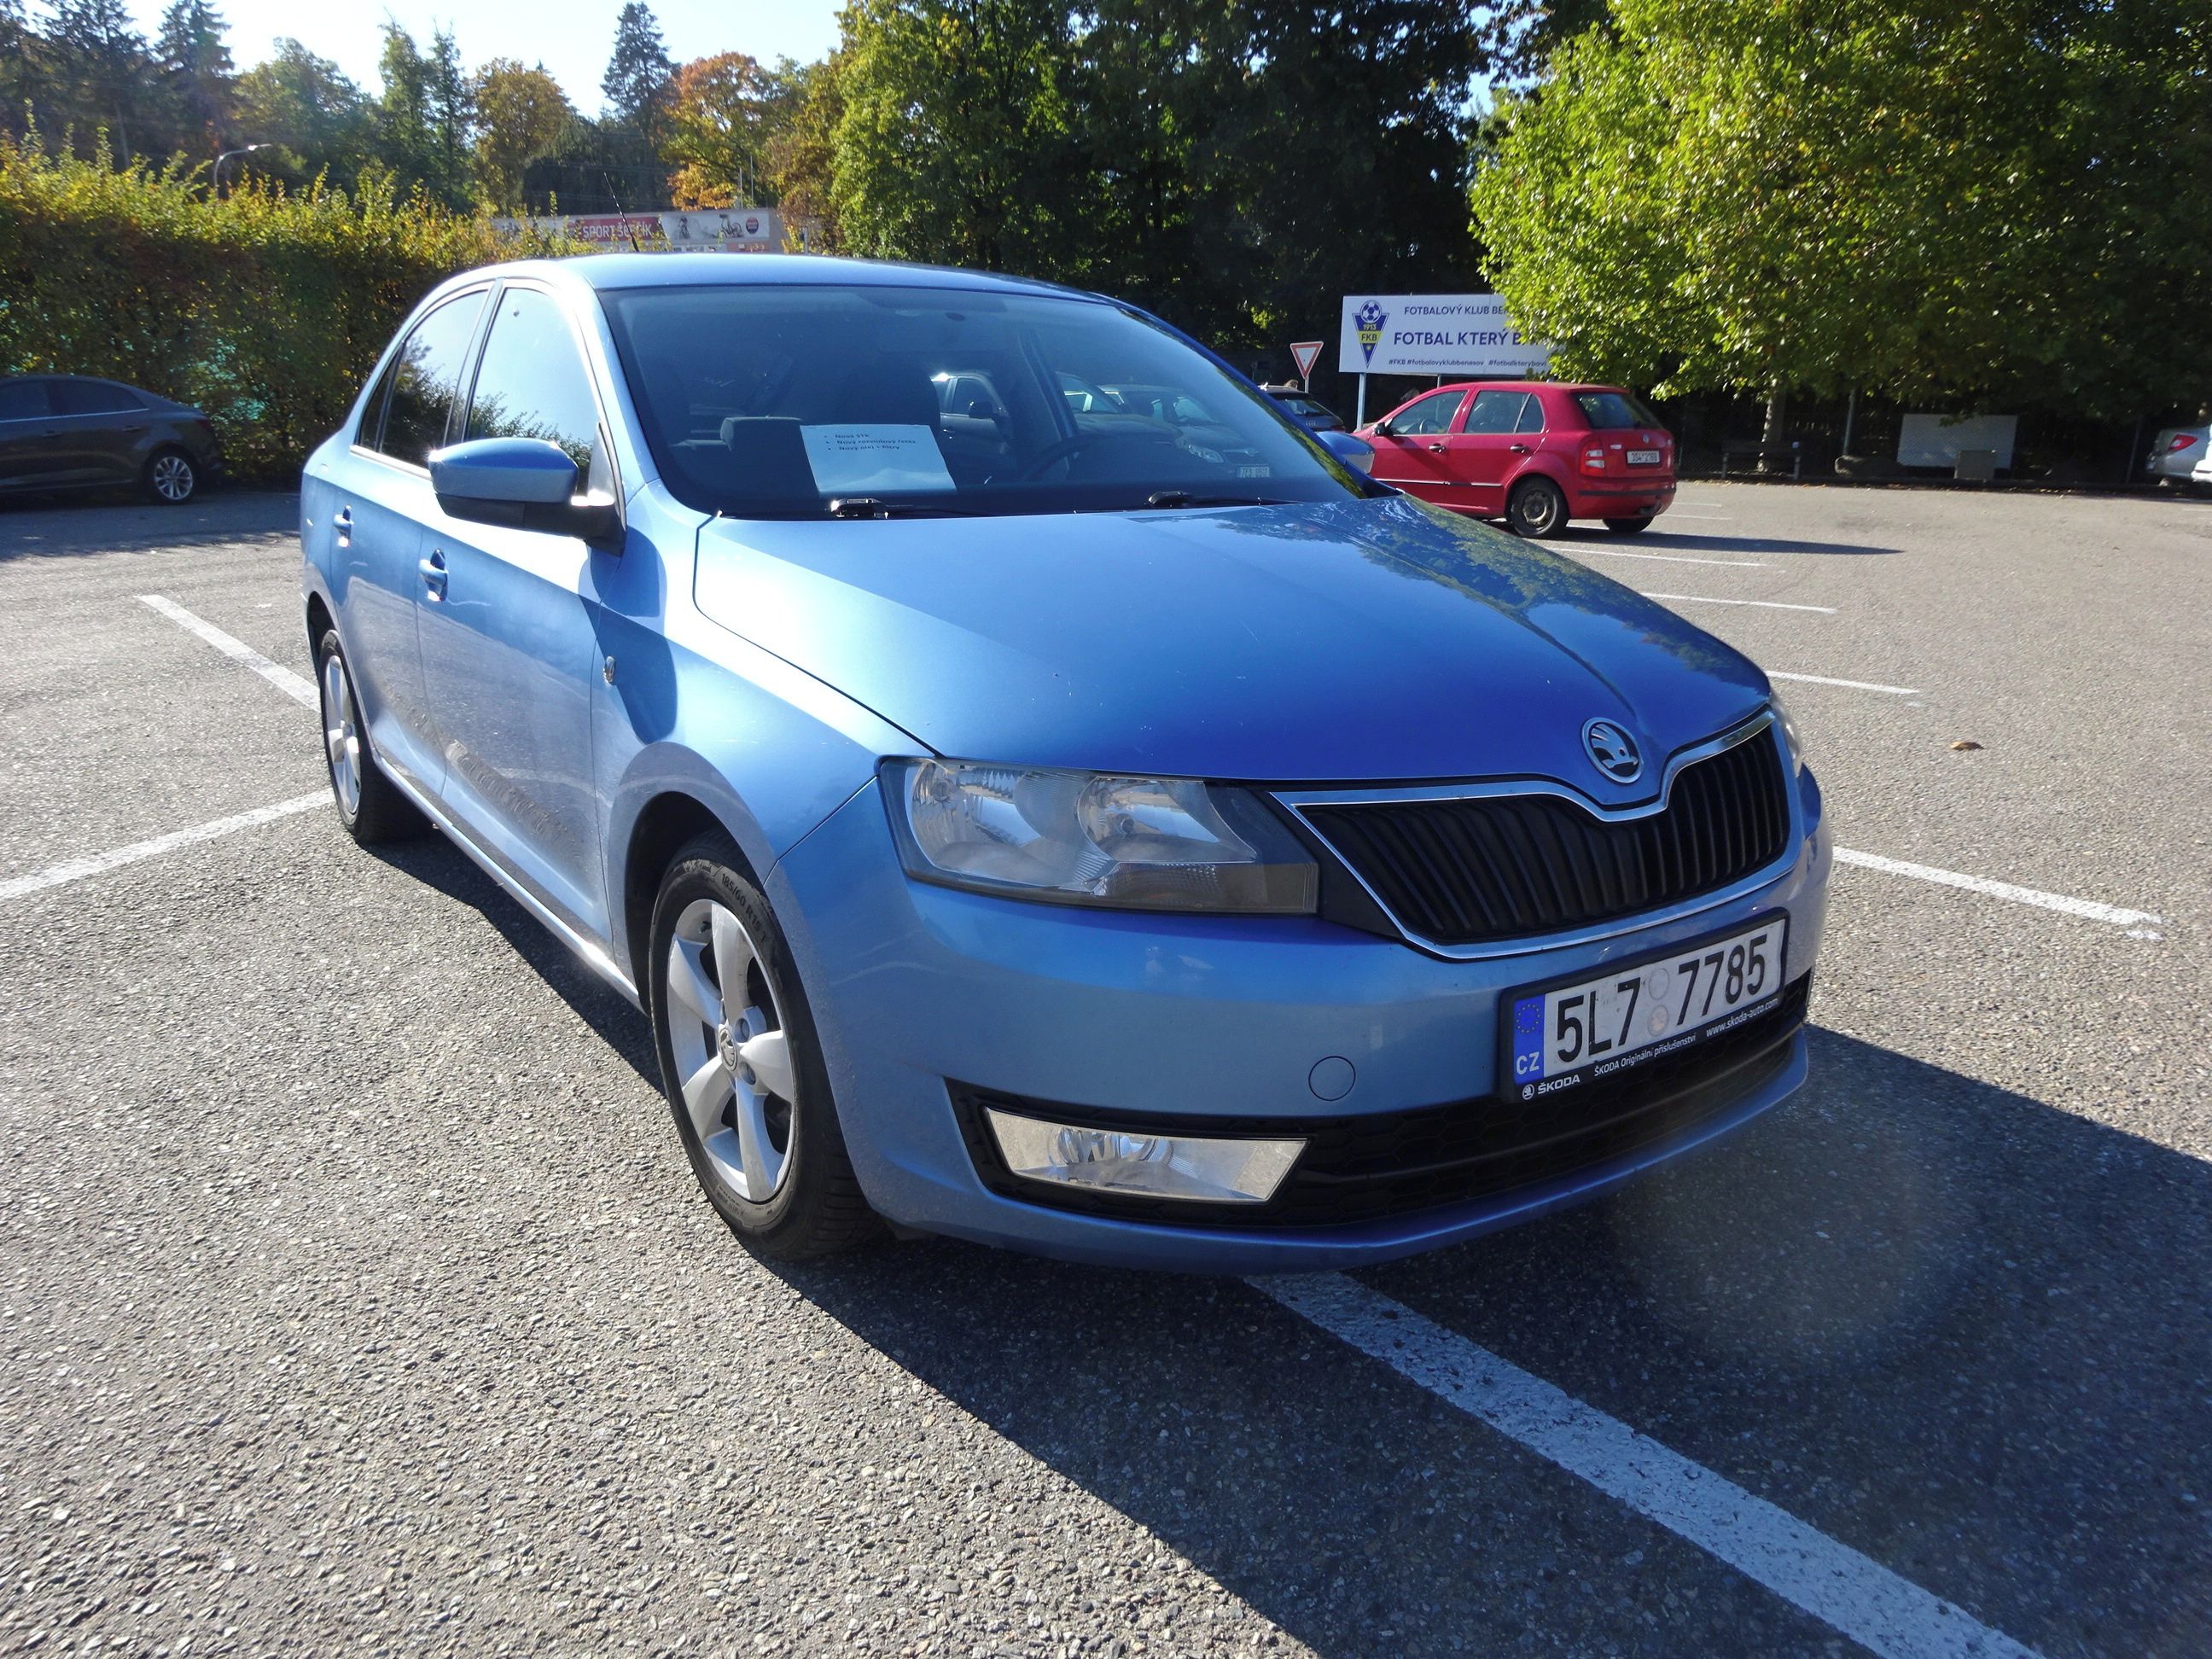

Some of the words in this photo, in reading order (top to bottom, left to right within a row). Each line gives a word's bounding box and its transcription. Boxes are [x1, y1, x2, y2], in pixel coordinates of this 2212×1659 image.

[583, 225, 615, 238] SPORT
[1404, 304, 1463, 315] FOTBALOVÝ
[1464, 306, 1490, 315] KLUB
[1394, 332, 1452, 346] FOTBAL
[1458, 328, 1509, 346] KTERÝ
[722, 873, 746, 906] 185/60
[1557, 977, 1641, 1062] 5L7
[1676, 934, 1767, 1026] 7785
[1706, 998, 1778, 1037] www.skoda-auto.com
[1516, 1051, 1540, 1075] CZ
[1594, 1060, 1620, 1076] ŠKODA
[1537, 1074, 1580, 1095] ŠKODA
